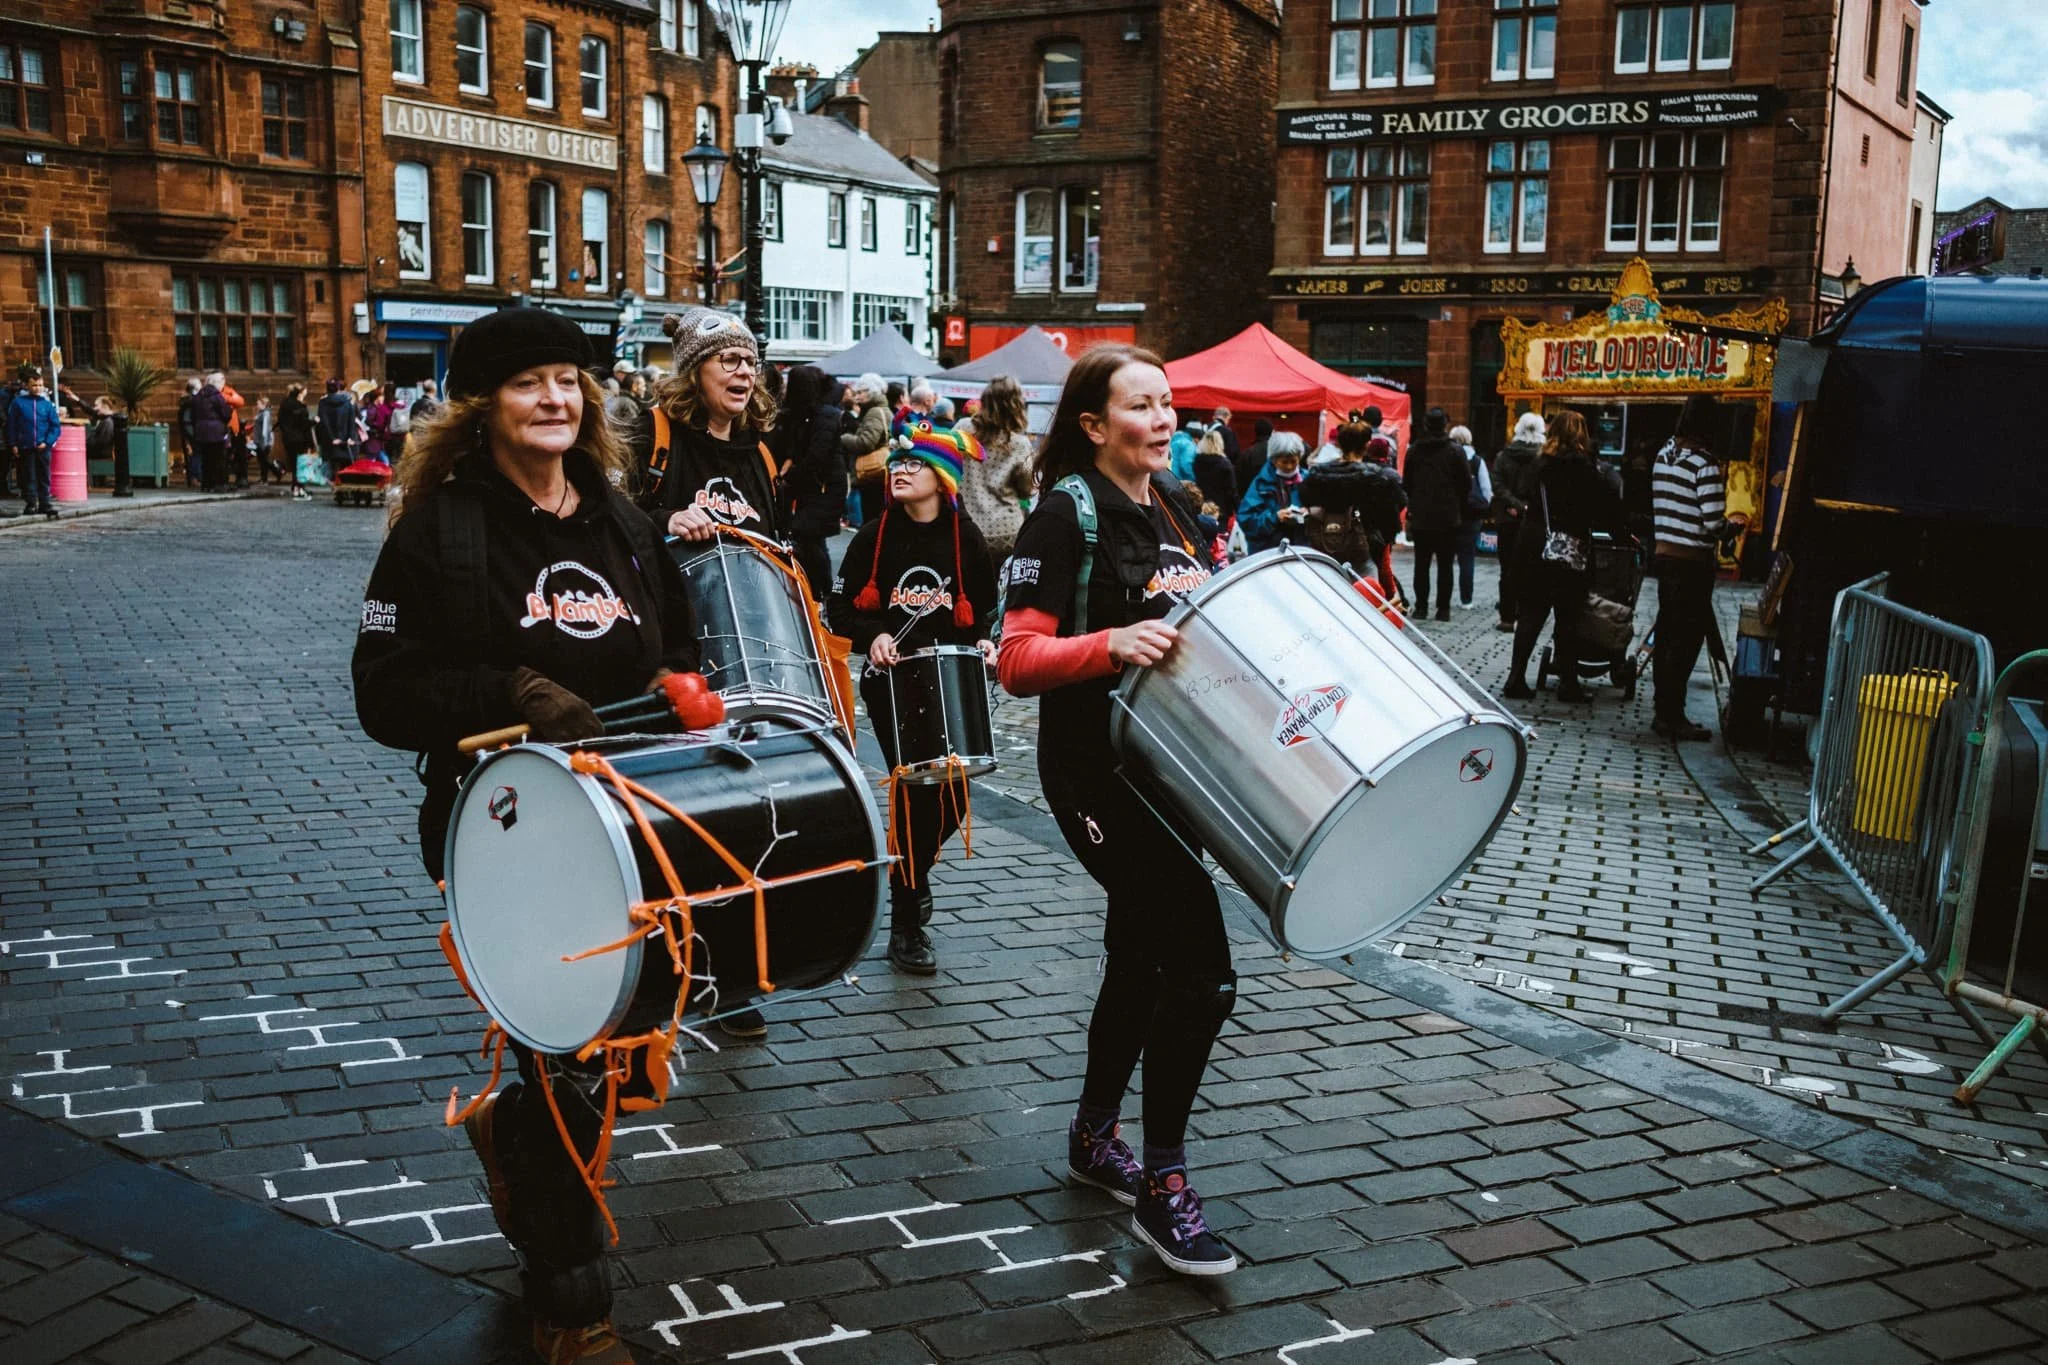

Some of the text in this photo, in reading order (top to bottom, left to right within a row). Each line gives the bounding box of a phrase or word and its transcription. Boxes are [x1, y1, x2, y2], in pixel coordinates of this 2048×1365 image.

[1661, 96, 1691, 106] ITALIAN
[1695, 103, 1723, 112] TEA &
[1291, 112, 1373, 124] AGRICULTURAL SEED
[1382, 101, 1649, 134] FAMILY GROCERS
[1659, 109, 1758, 123] PROVISION MERCHANTS
[1315, 121, 1347, 131] CAKE &
[396, 104, 611, 164] ADVERTISER OFFICE
[1325, 128, 1373, 140] MERCHANTS
[1296, 280, 1348, 293] JAMES
[1400, 279, 1447, 293] JOHN
[1567, 277, 1618, 292] GRAH
[1542, 334, 1728, 381] MELODROME
[367, 600, 397, 614] Blue
[366, 612, 396, 625] Jam
